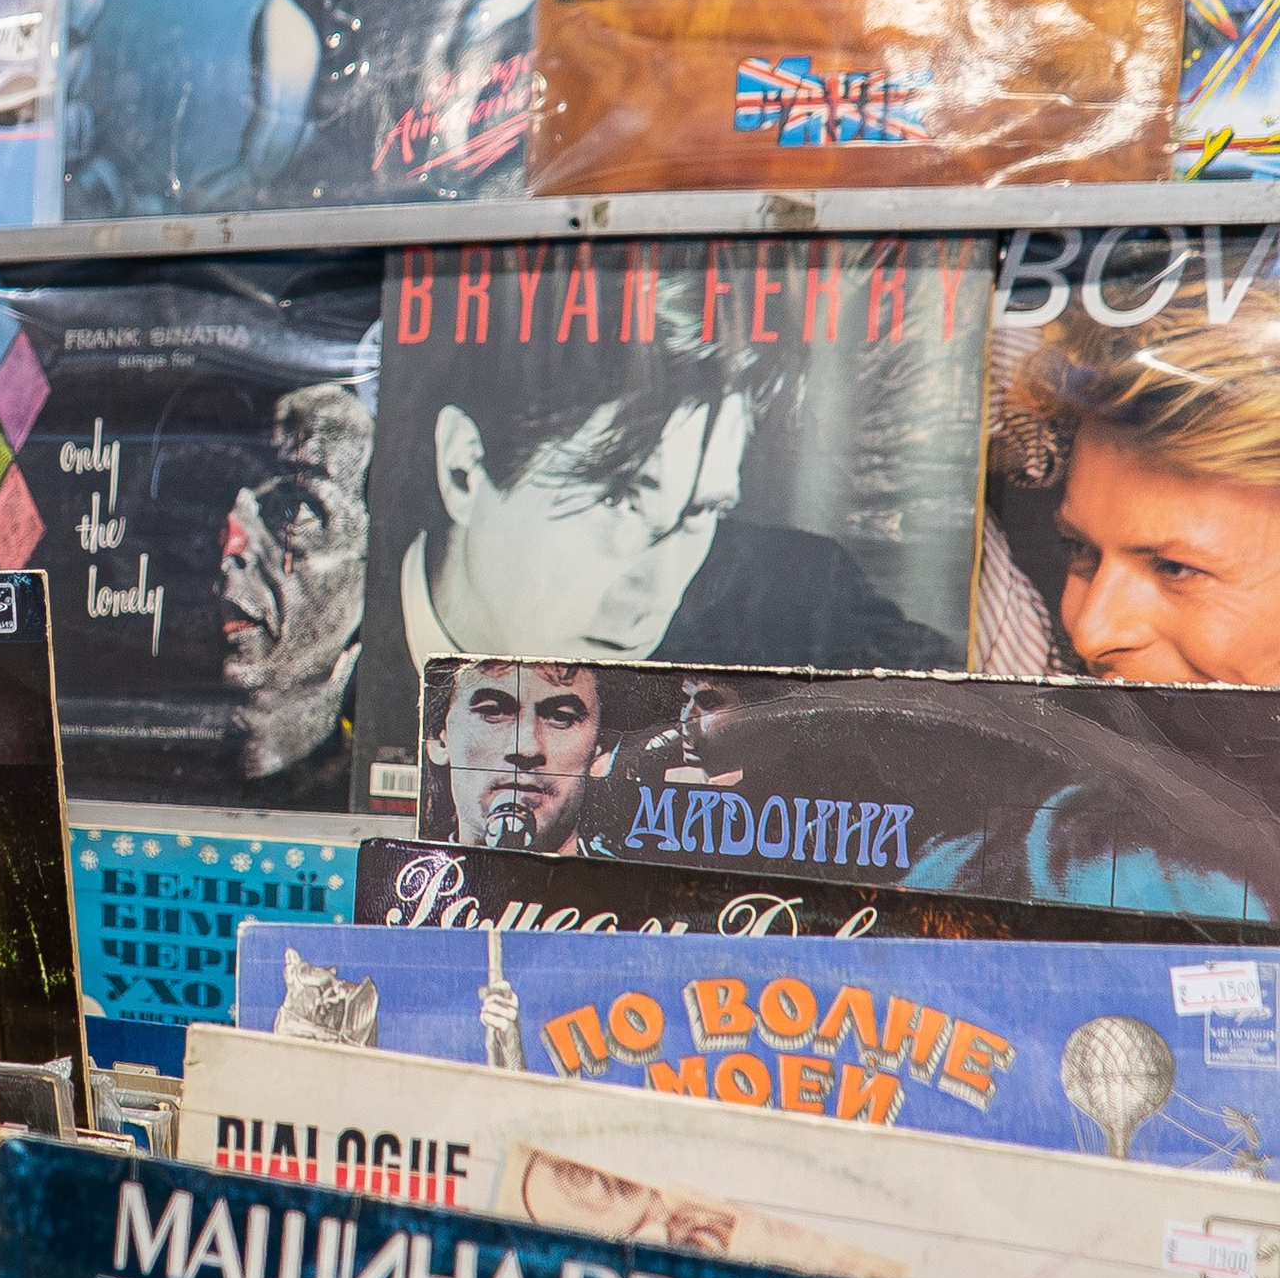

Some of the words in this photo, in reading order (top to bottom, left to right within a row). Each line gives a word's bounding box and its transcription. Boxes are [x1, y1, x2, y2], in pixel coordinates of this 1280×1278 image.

[396, 238, 658, 344] BRYAN
[702, 235, 970, 342] FERRY
[64, 328, 142, 349] FRANK
[60, 417, 120, 515] only
[75, 491, 126, 554] the
[87, 553, 164, 657] lonely
[101, 868, 328, 914] БЕЛЫЙ
[101, 902, 236, 938] БИМ
[102, 972, 223, 1009] УХО
[540, 990, 666, 1079] ПО
[684, 976, 1016, 1115] ВОЛНЕ
[645, 1052, 906, 1127] МОЕЙ
